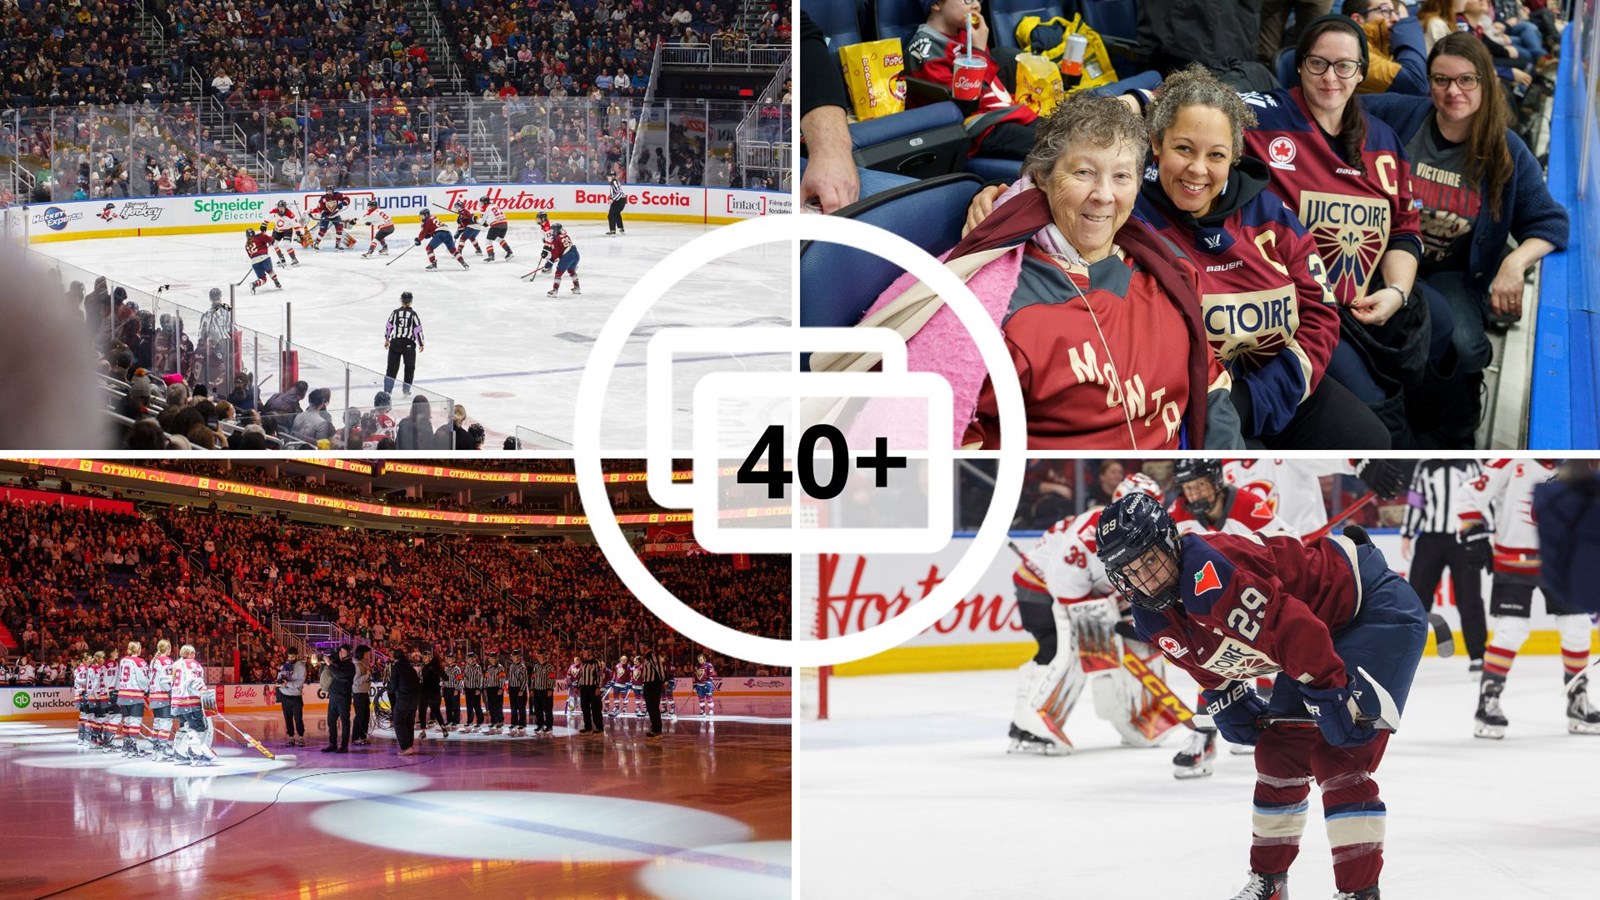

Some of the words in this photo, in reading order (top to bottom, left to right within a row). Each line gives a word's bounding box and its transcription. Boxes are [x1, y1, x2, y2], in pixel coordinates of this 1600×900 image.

[1144, 167, 1159, 181] 29
[1416, 162, 1461, 188] VICTOIRE
[194, 198, 264, 212] Schneider
[576, 190, 638, 204] Bane
[642, 191, 690, 206] Scotia
[732, 198, 761, 210] intact
[120, 205, 163, 220] Hockey
[224, 212, 263, 220] Electric
[1306, 199, 1387, 237] VICTOIRE
[1206, 261, 1243, 272] BAUER
[399, 317, 408, 327] 31
[1200, 296, 1292, 336] CTOIRE
[44, 468, 56, 476] 101
[102, 465, 147, 479] OTTAWA
[449, 470, 480, 480] OTTAWA
[536, 475, 567, 483] OTTAWA
[217, 482, 255, 496] OTTAWA
[314, 497, 346, 509] OTTAWA
[397, 509, 431, 520] OTTAWA
[483, 516, 516, 524] OTTAWA
[1102, 519, 1117, 536] 29
[1064, 545, 1088, 569] 38
[1228, 587, 1268, 641] 29
[234, 686, 257, 699] Barbie
[1123, 653, 1193, 722] CCM
[1206, 681, 1254, 717] BAUER
